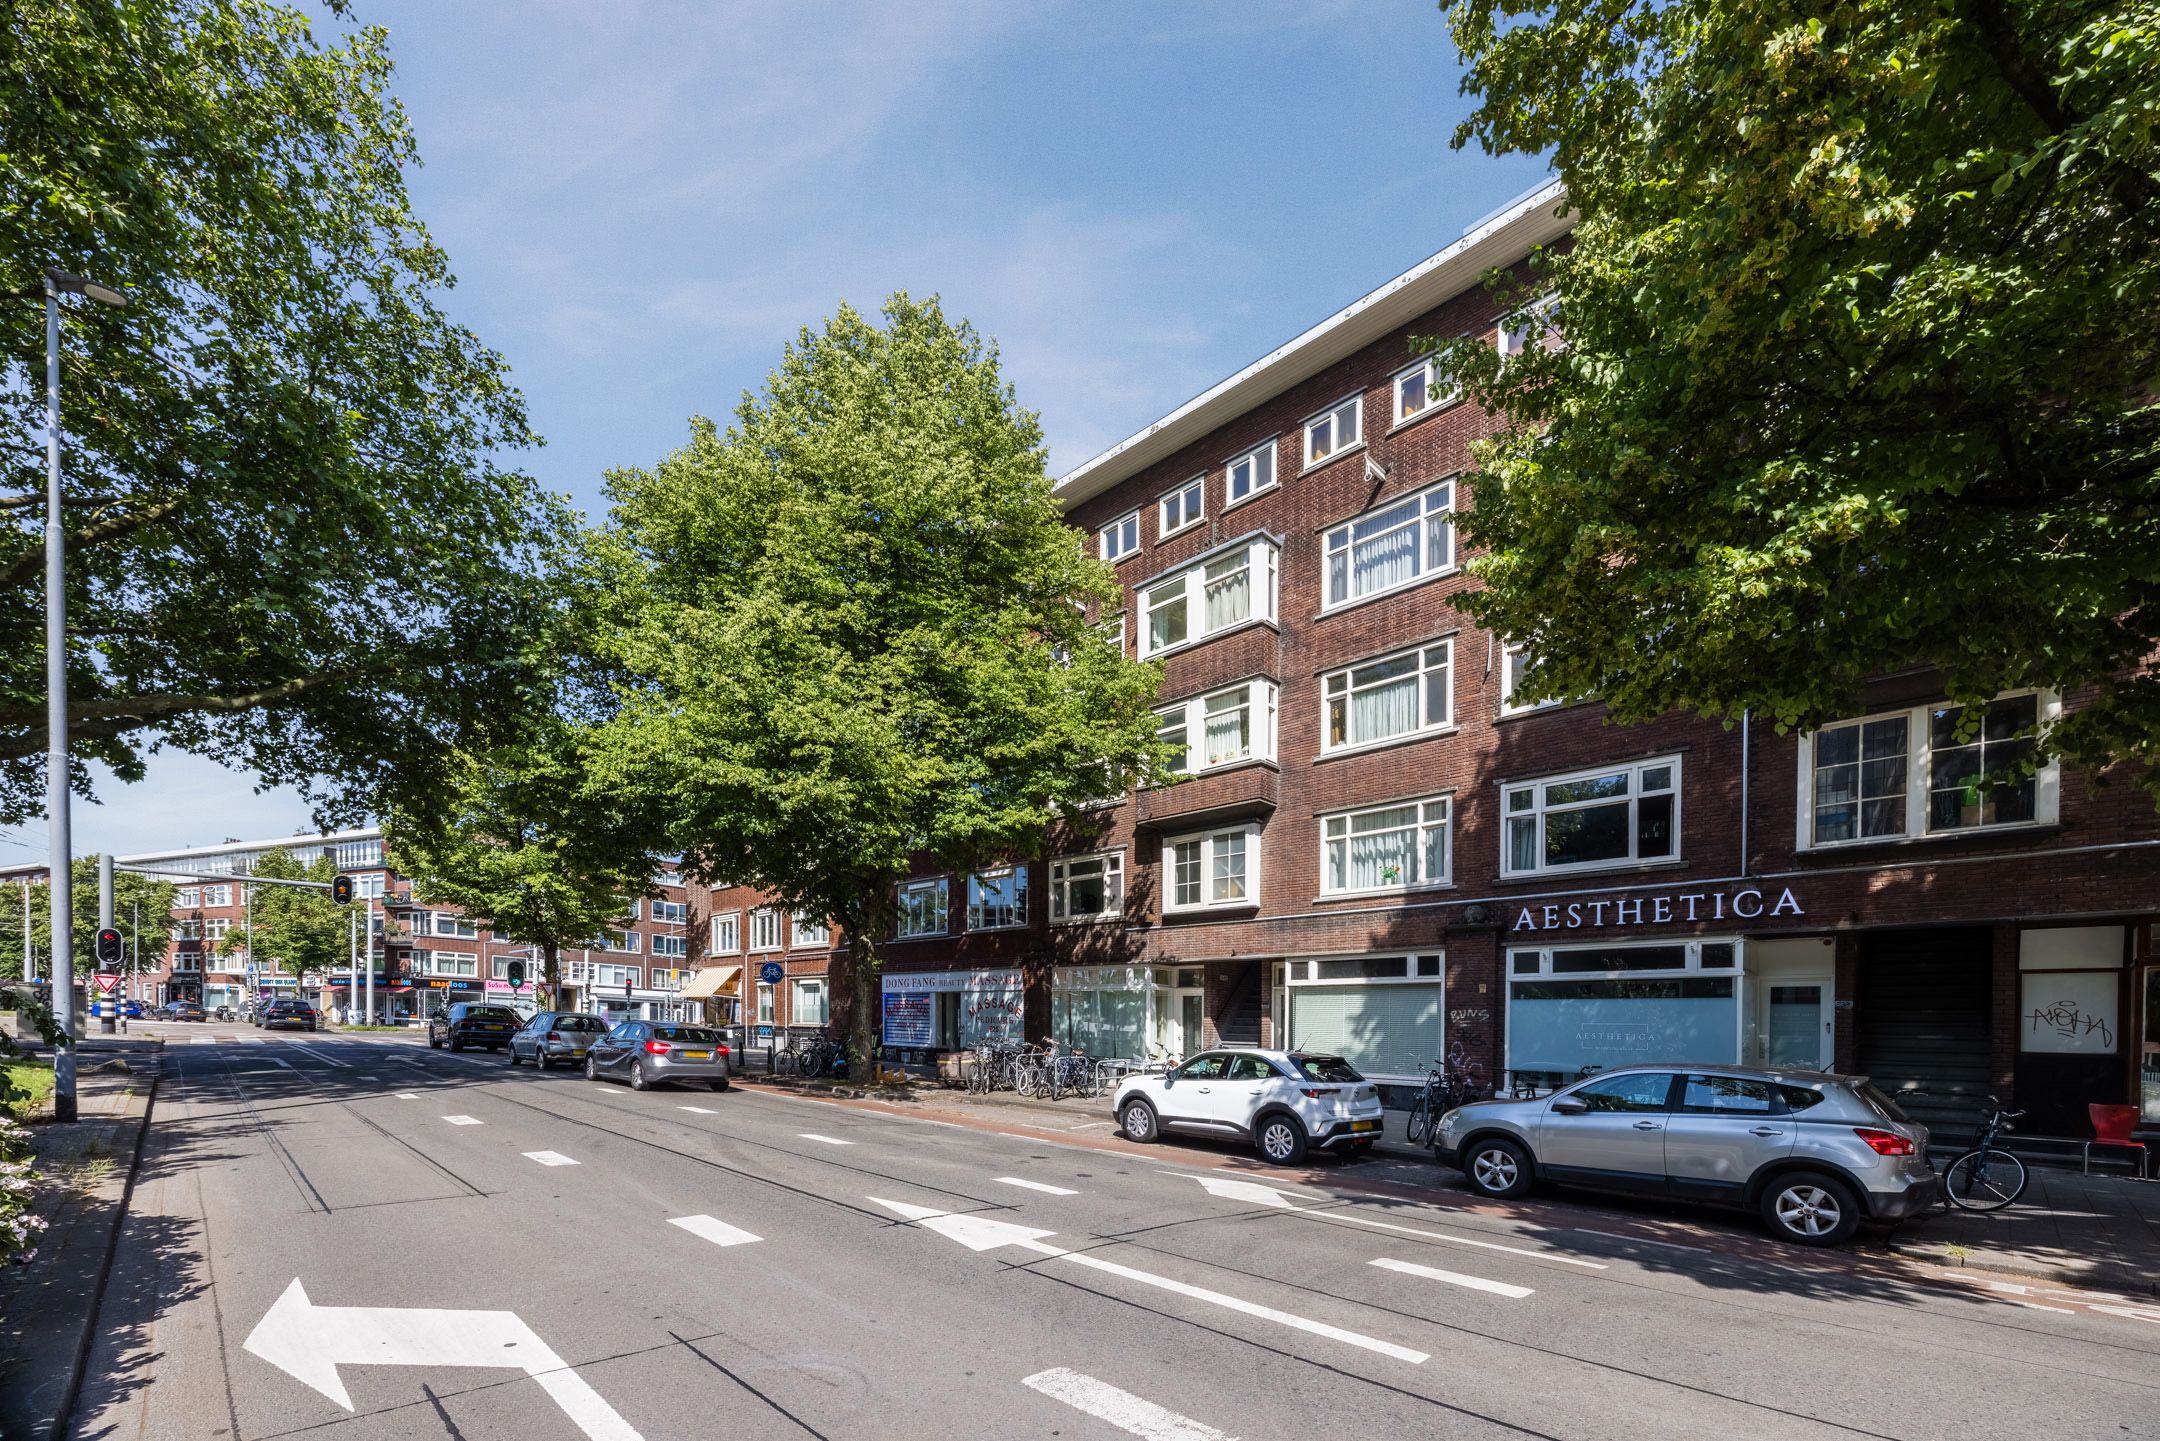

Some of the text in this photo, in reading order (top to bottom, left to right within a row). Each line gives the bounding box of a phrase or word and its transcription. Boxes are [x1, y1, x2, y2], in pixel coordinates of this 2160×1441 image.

[1512, 887, 1805, 931] AESTHETICA
[430, 980, 468, 989] naadloos
[885, 979, 910, 988] DONG
[911, 977, 936, 987] FANG
[969, 974, 1021, 986] MASSAGE
[968, 998, 1022, 1019] MASSAGE
[1575, 1032, 1655, 1041] AESTHETICA
